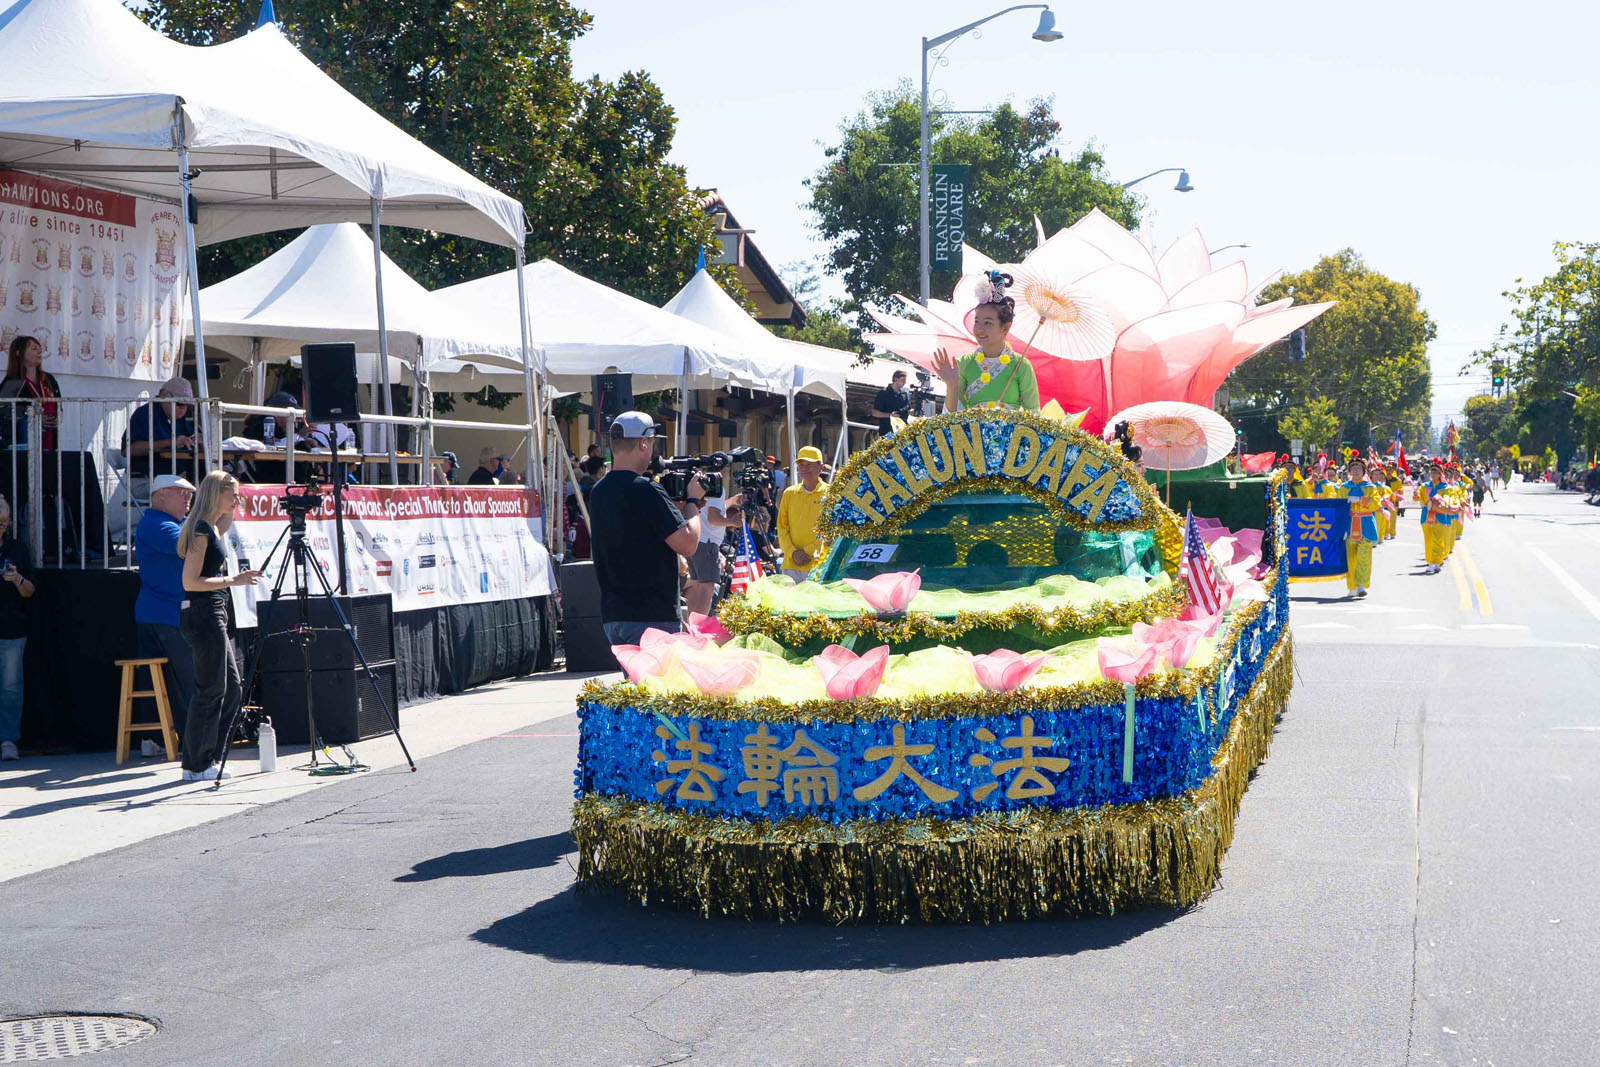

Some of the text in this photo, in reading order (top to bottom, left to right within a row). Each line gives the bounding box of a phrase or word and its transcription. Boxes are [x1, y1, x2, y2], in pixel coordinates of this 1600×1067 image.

[46, 215, 81, 235] since
[89, 223, 125, 242] 1945!
[935, 173, 949, 262] FRANKLIN
[949, 182, 965, 253] SQUARE
[839, 421, 1119, 525] FALUN DAFA
[250, 494, 268, 517] SC
[384, 496, 423, 521] Special
[450, 496, 461, 515] to
[473, 500, 487, 515] our
[1297, 510, 1332, 542] 法
[857, 547, 884, 560] 58
[1297, 546, 1323, 565] FA
[651, 715, 1071, 807] 法輪大法
